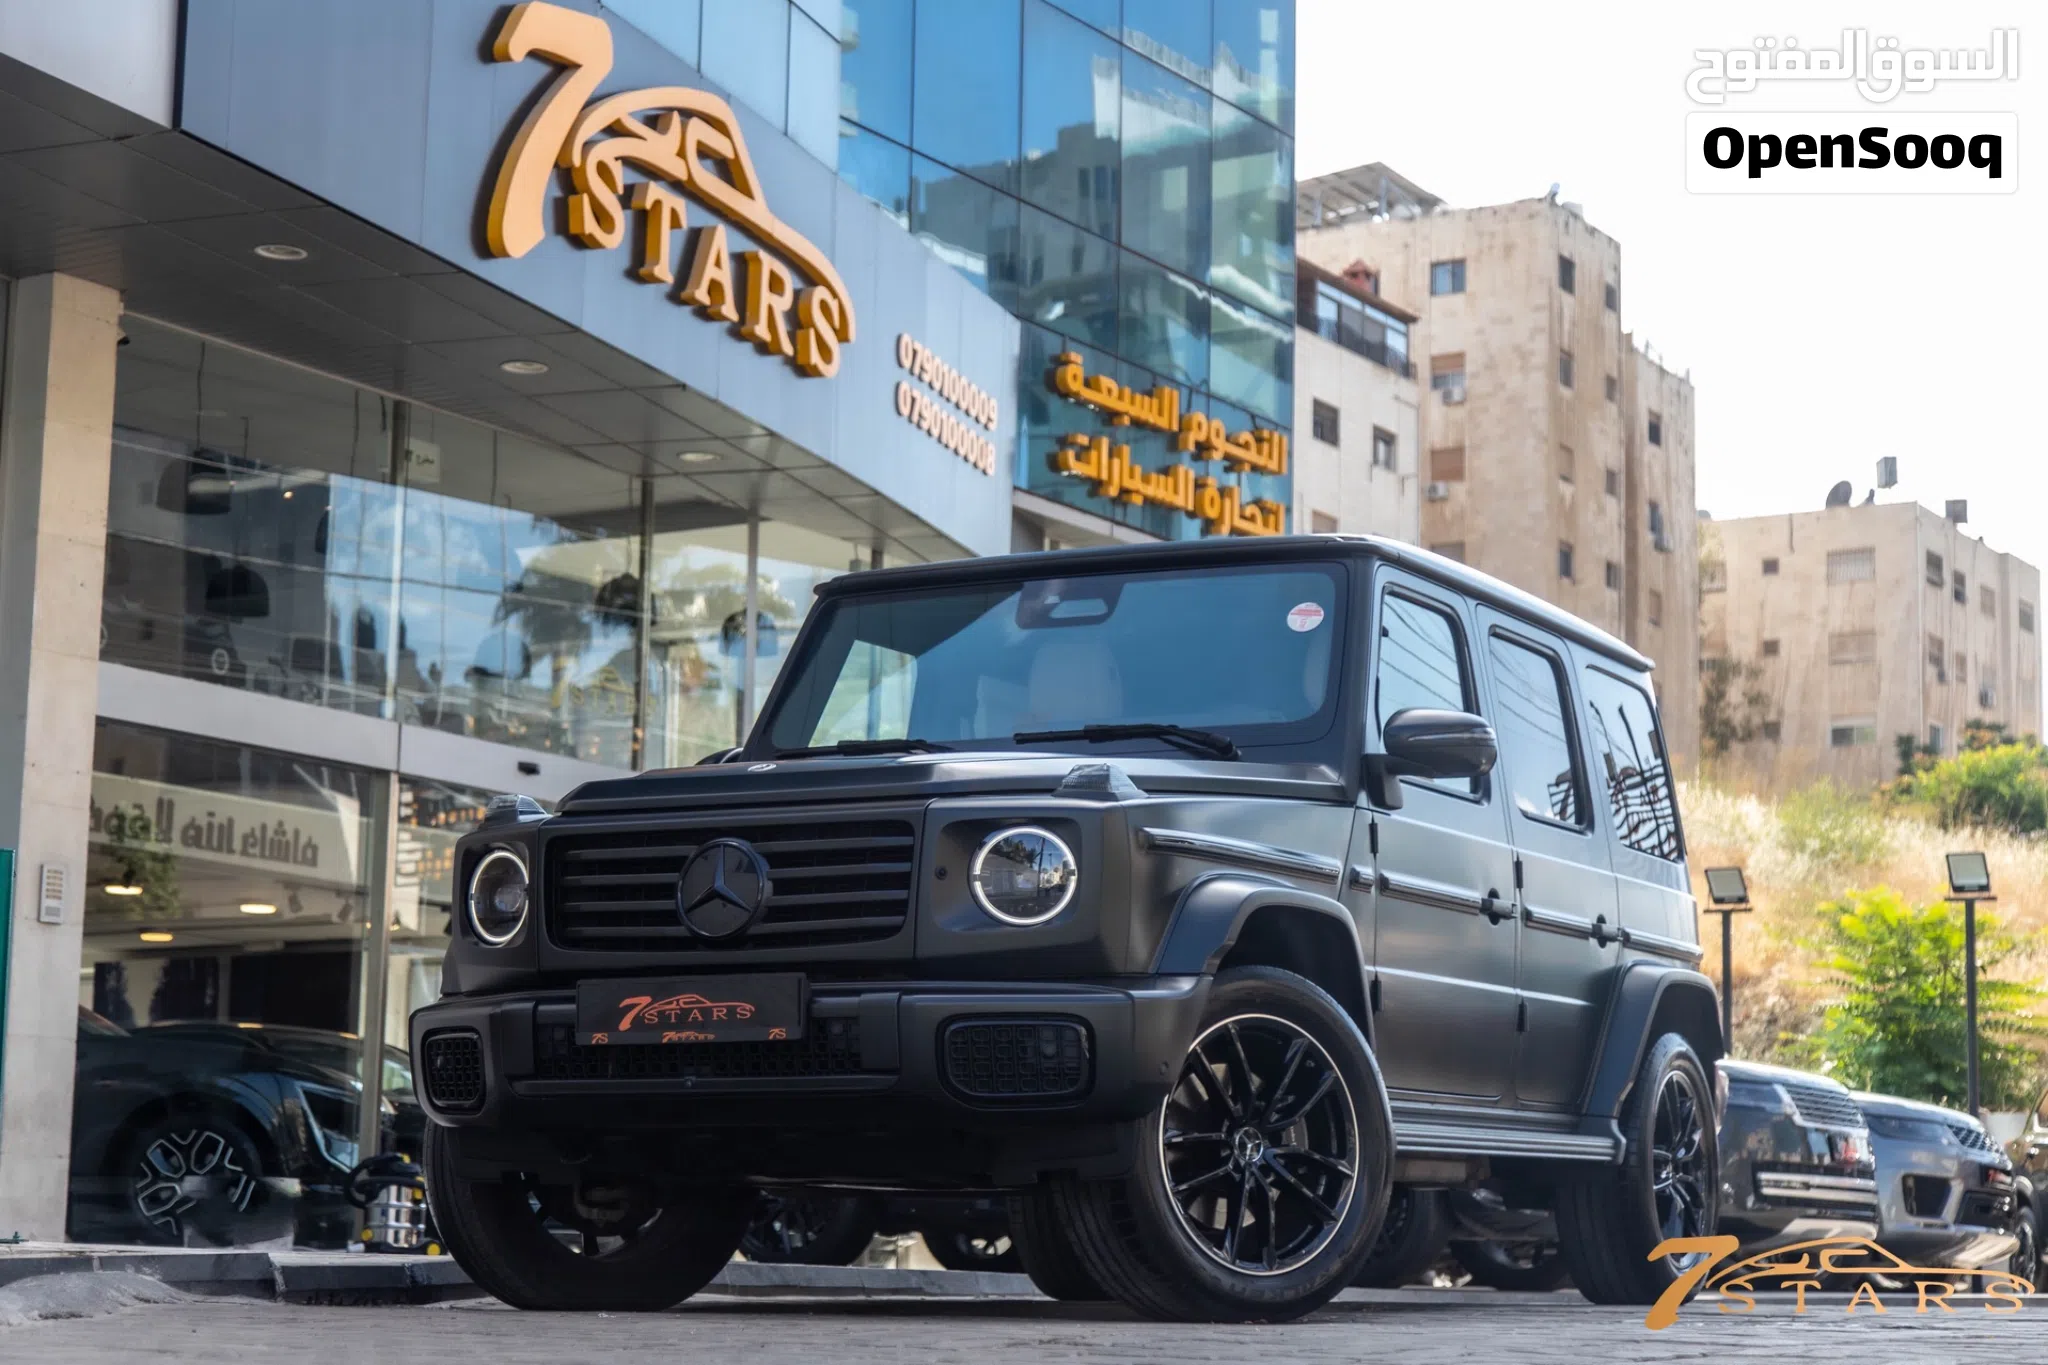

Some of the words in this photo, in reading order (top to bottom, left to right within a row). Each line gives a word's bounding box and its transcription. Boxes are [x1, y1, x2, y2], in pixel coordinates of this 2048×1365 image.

[487, 1, 613, 259] 7
[568, 150, 841, 378] STARS
[898, 332, 998, 431] 0790100009
[1056, 352, 1179, 432] السبعة
[896, 380, 996, 476] 0790100008
[1179, 412, 1288, 475] النجوم
[1058, 433, 1195, 511] السيارات
[618, 996, 652, 1032] 7
[644, 1007, 752, 1025] STARS
